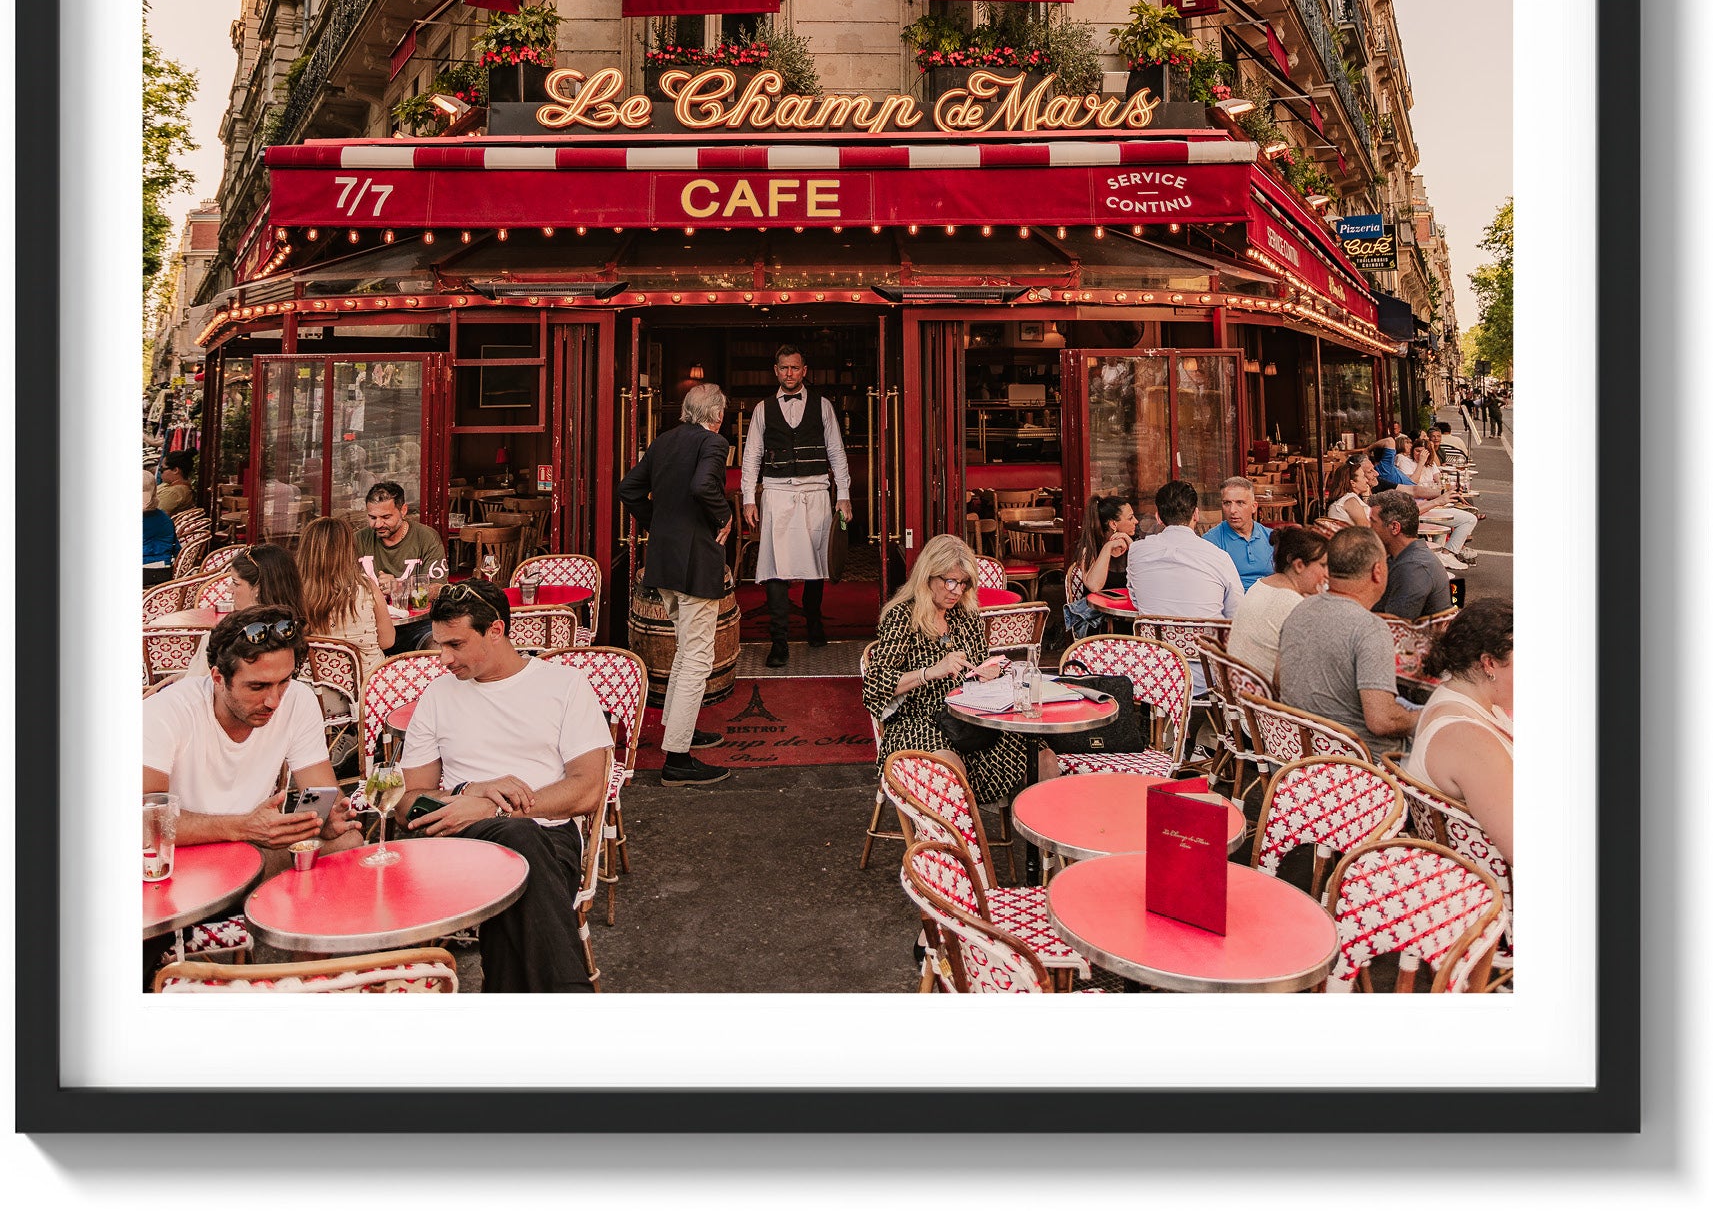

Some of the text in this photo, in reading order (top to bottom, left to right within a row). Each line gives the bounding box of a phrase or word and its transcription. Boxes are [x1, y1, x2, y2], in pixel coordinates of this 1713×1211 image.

[535, 67, 1162, 134] Le Champ de Mars
[1107, 172, 1188, 190] SERVICE
[335, 176, 394, 217] 7/7
[681, 179, 841, 218] CAFE
[1106, 195, 1192, 213] CONTINU
[1340, 223, 1381, 234] Pizzeria
[1343, 234, 1393, 255] Café
[726, 725, 788, 734] BISTROT
